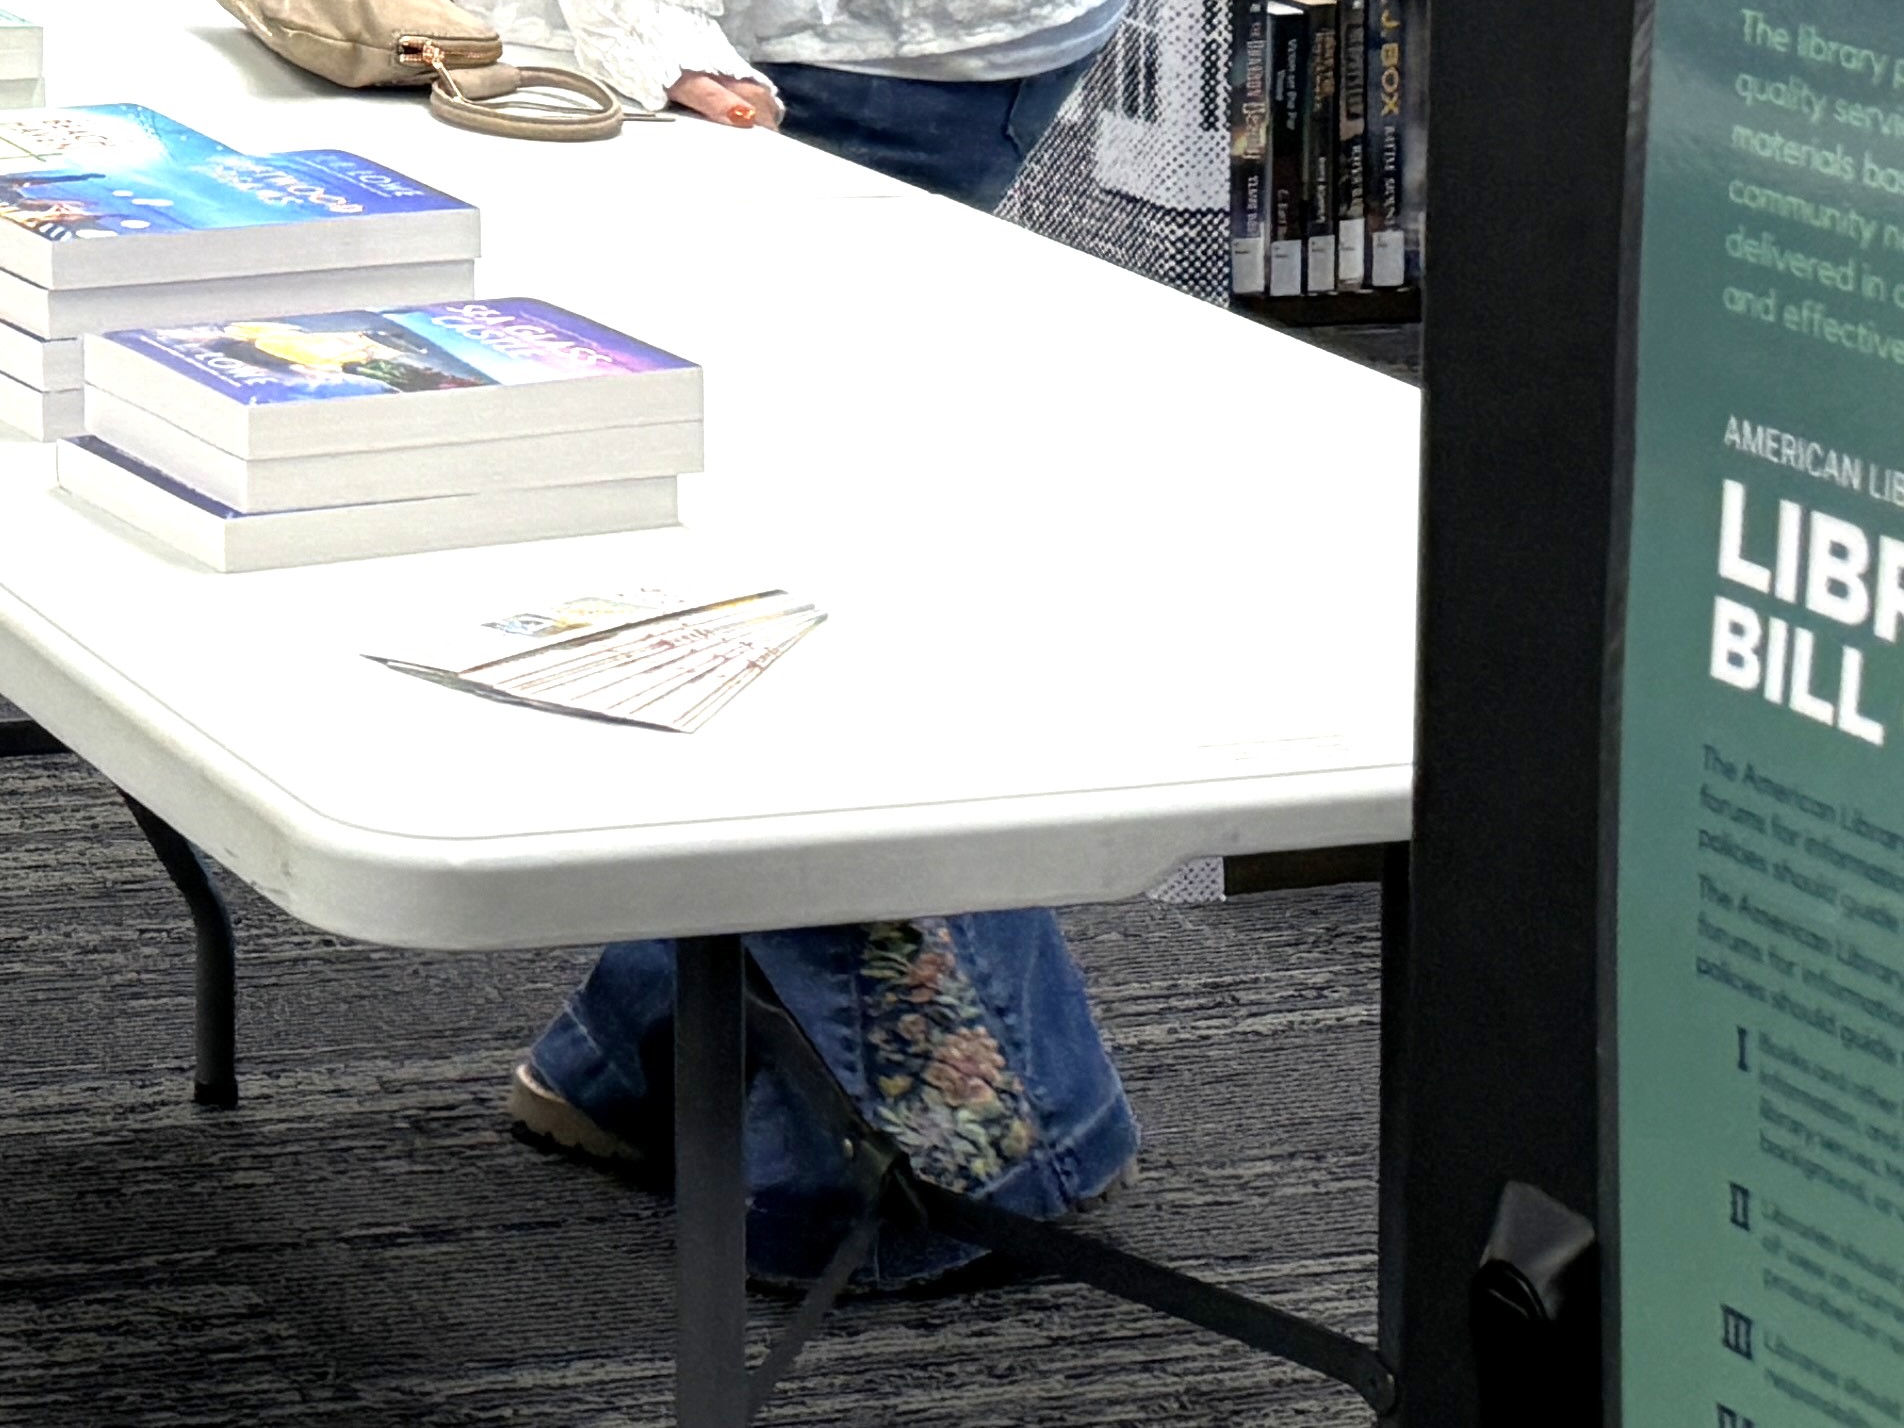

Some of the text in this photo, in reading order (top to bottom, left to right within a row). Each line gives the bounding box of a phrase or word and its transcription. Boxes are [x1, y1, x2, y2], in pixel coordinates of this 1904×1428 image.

[1740, 7, 1890, 86] The library
[1381, 43, 1399, 117] BOX
[1735, 73, 1828, 125] quality
[340, 170, 429, 197] LOWE
[1731, 125, 1856, 183] materials
[1728, 179, 1878, 250] community
[1724, 224, 1886, 302] delivered in
[440, 304, 620, 365] SEA GLASS
[1722, 285, 1777, 323] and
[418, 315, 554, 358] CASTLE
[186, 353, 286, 385] LOWE
[1722, 413, 1862, 492] AMERICAN
[1708, 594, 1886, 744] BILL
